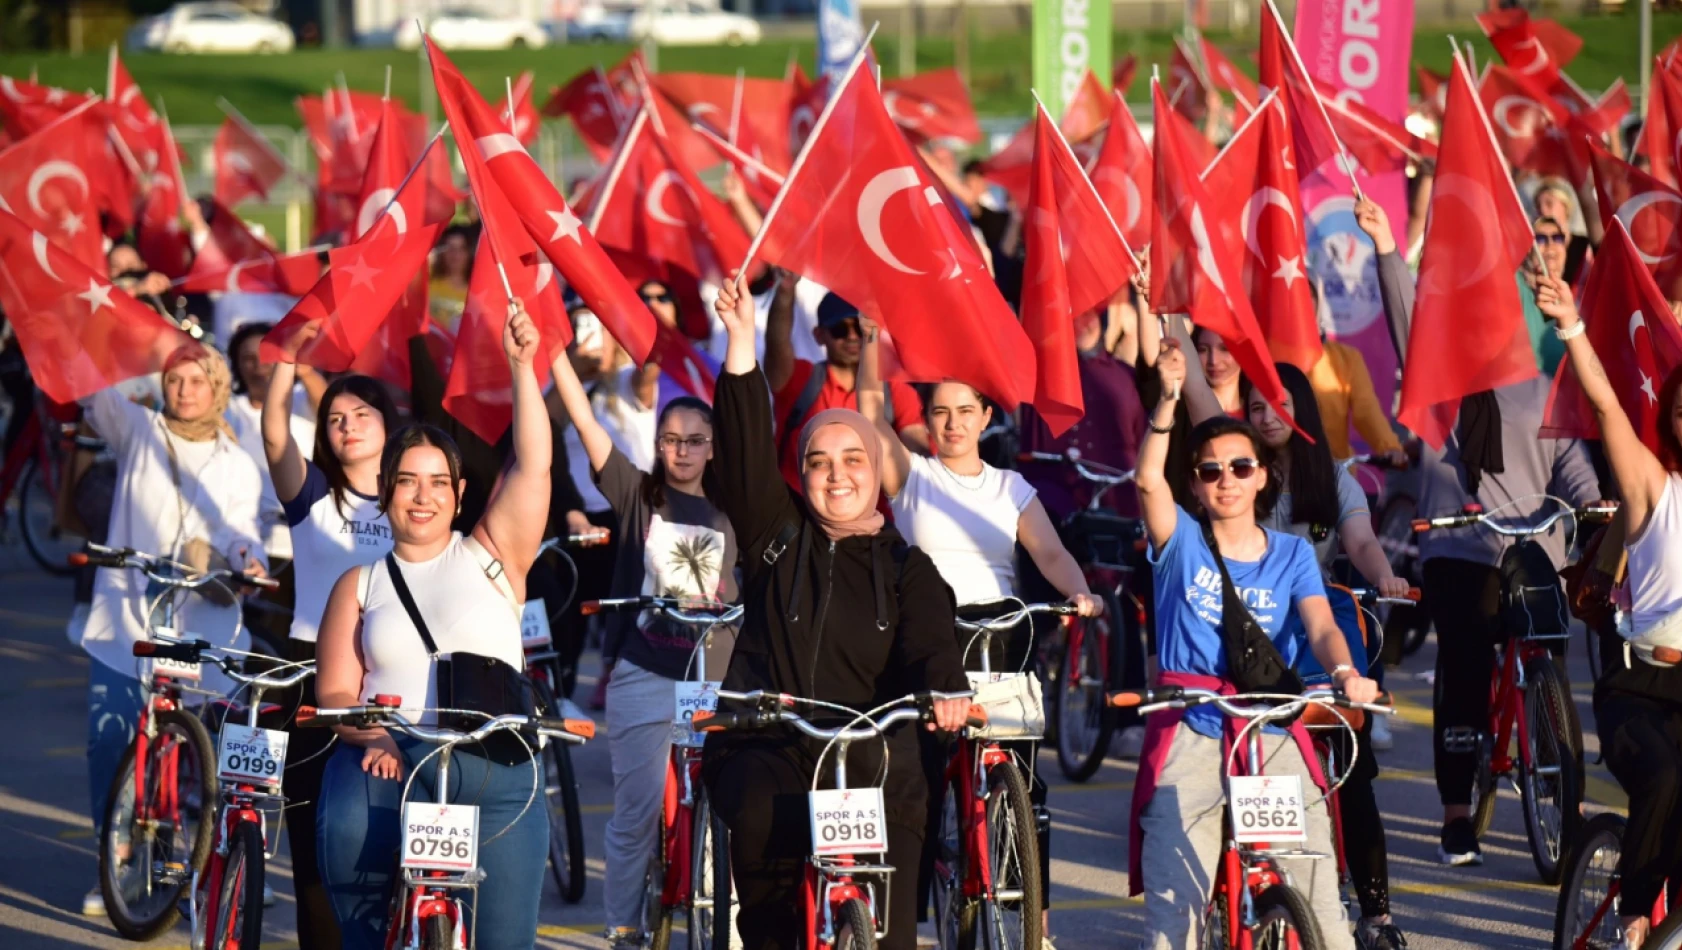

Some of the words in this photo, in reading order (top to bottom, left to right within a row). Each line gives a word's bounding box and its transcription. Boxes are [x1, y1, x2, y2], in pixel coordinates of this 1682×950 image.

[339, 520, 394, 541] ATLANT
[679, 698, 709, 709] SPOR
[226, 742, 257, 756] SPOR
[227, 754, 278, 776] 0199
[1236, 796, 1271, 807] SPOR
[816, 809, 851, 822] SPOR
[1241, 809, 1299, 828] 0562
[408, 824, 444, 836] SPOR
[821, 822, 878, 842] 0918
[409, 837, 470, 859] 0796
